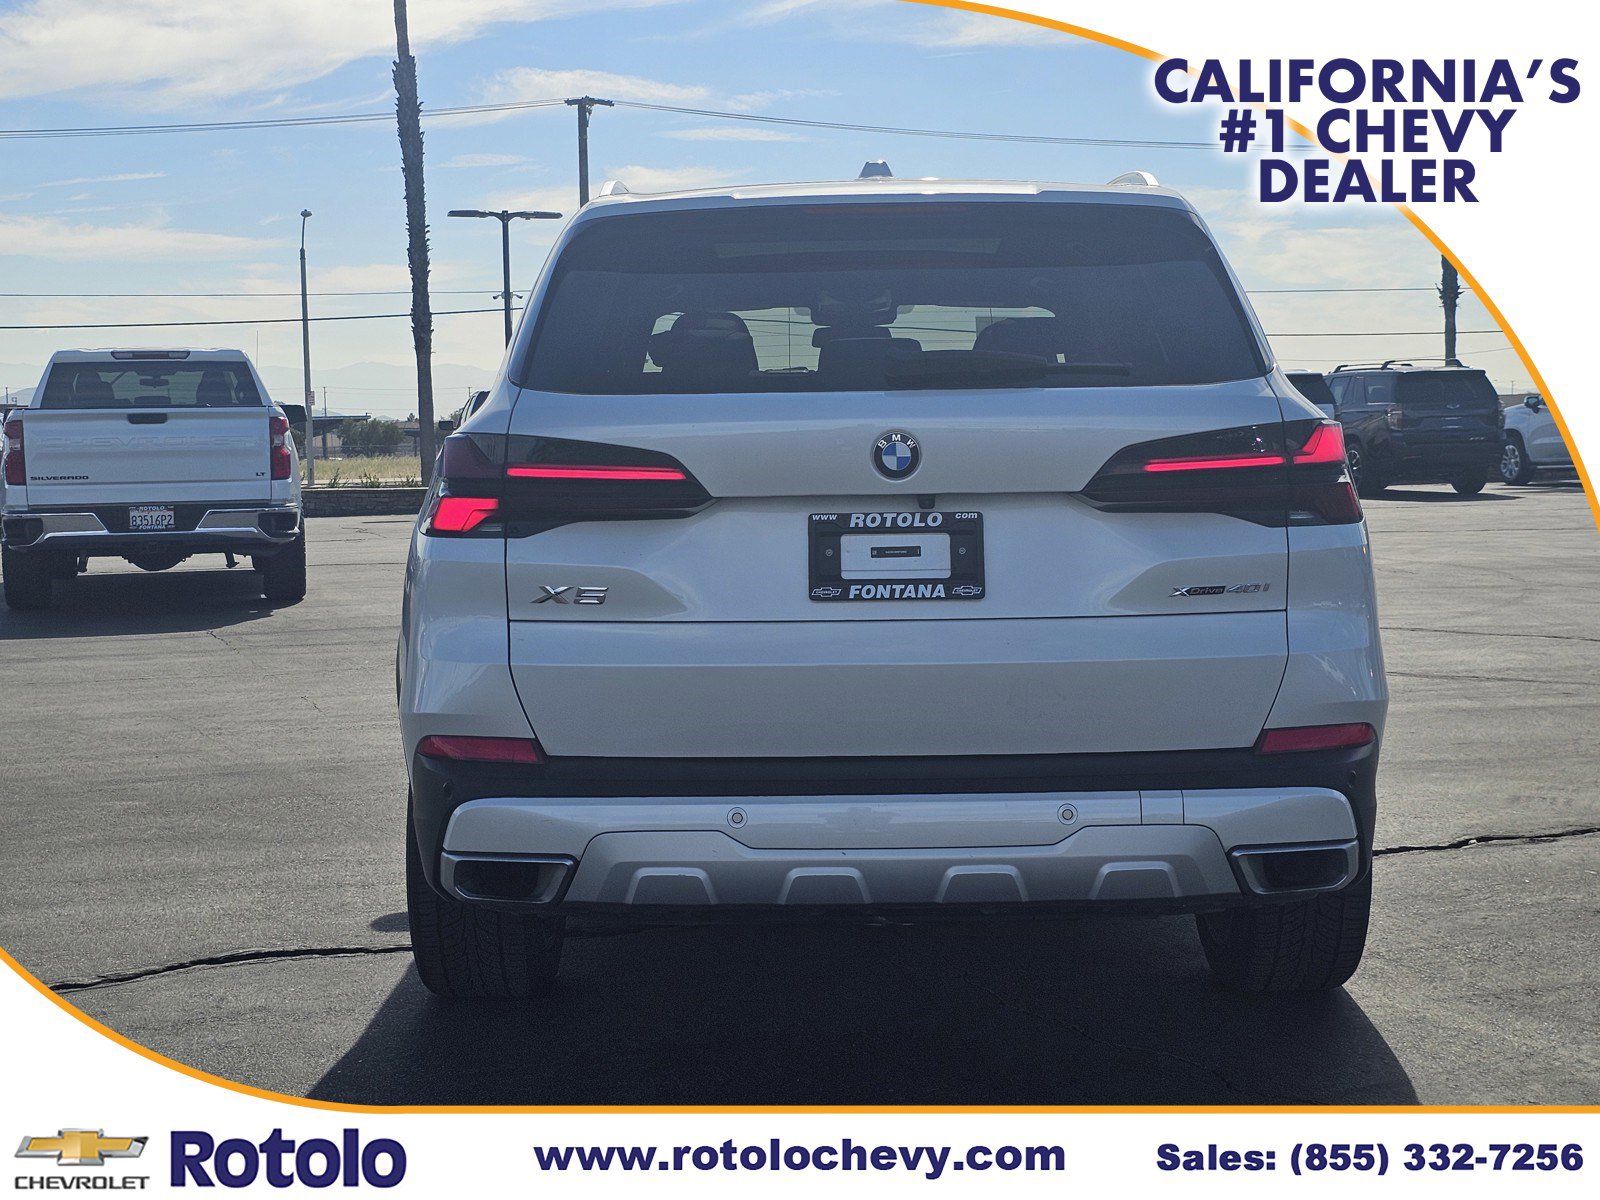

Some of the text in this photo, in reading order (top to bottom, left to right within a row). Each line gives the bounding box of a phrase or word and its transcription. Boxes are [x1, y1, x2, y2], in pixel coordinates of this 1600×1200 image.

[878, 434, 916, 449] BMW
[850, 512, 943, 528] ROTOLO
[529, 585, 609, 605] X5
[849, 584, 946, 599] FONTANA
